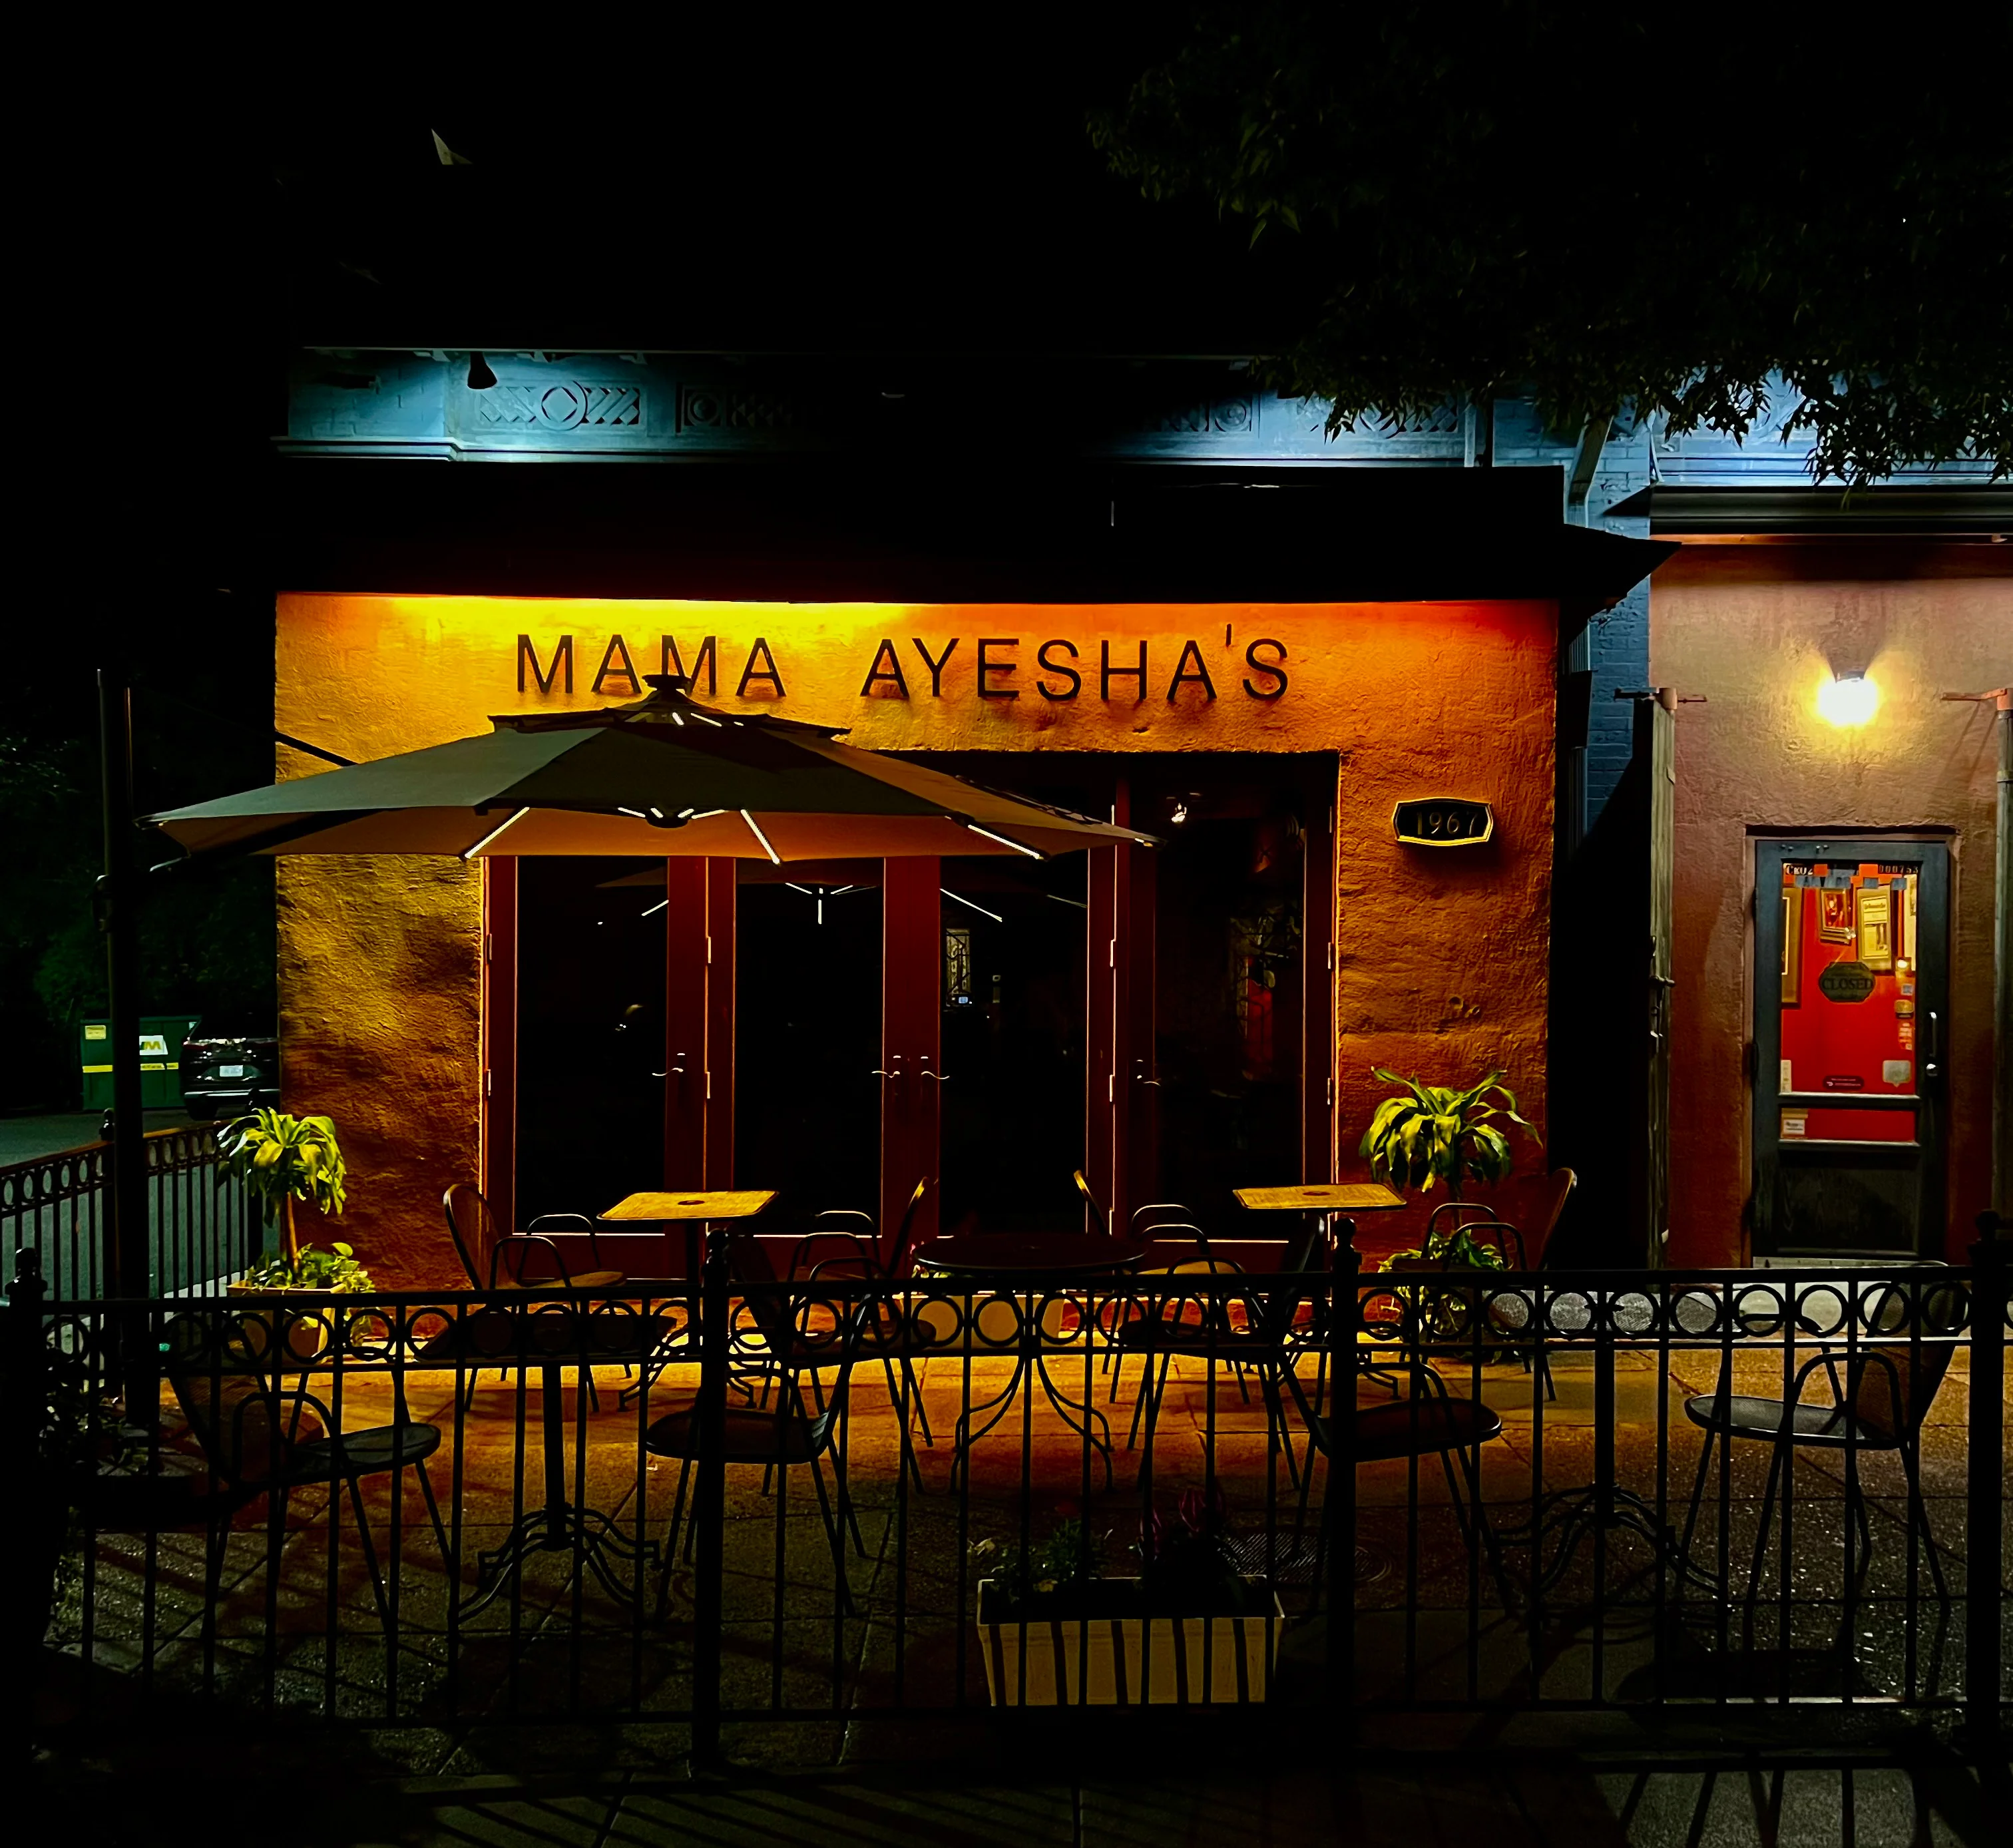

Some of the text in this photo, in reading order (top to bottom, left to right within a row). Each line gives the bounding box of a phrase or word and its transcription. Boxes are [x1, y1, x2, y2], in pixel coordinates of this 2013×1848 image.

[517, 623, 1289, 702] MAMA AYESHA'S
[1416, 811, 1478, 836] 1967
[1821, 977, 1874, 991] CLOSED
